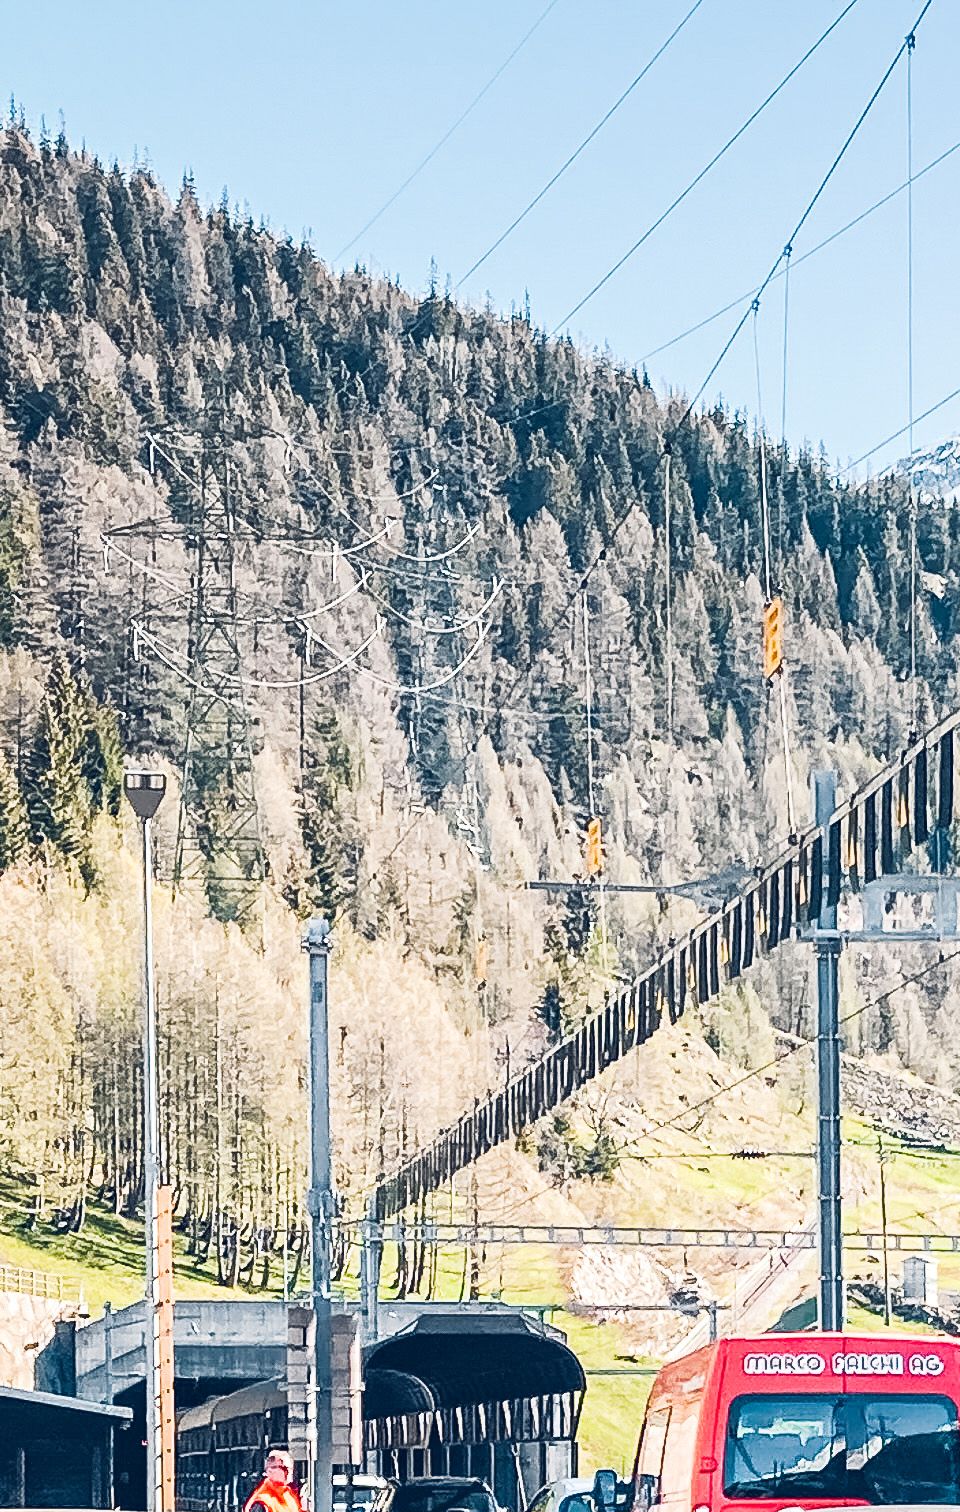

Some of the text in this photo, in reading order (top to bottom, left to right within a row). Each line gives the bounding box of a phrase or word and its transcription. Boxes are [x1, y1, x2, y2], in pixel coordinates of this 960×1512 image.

[745, 1355, 943, 1374] MARCO FALCHI AG
